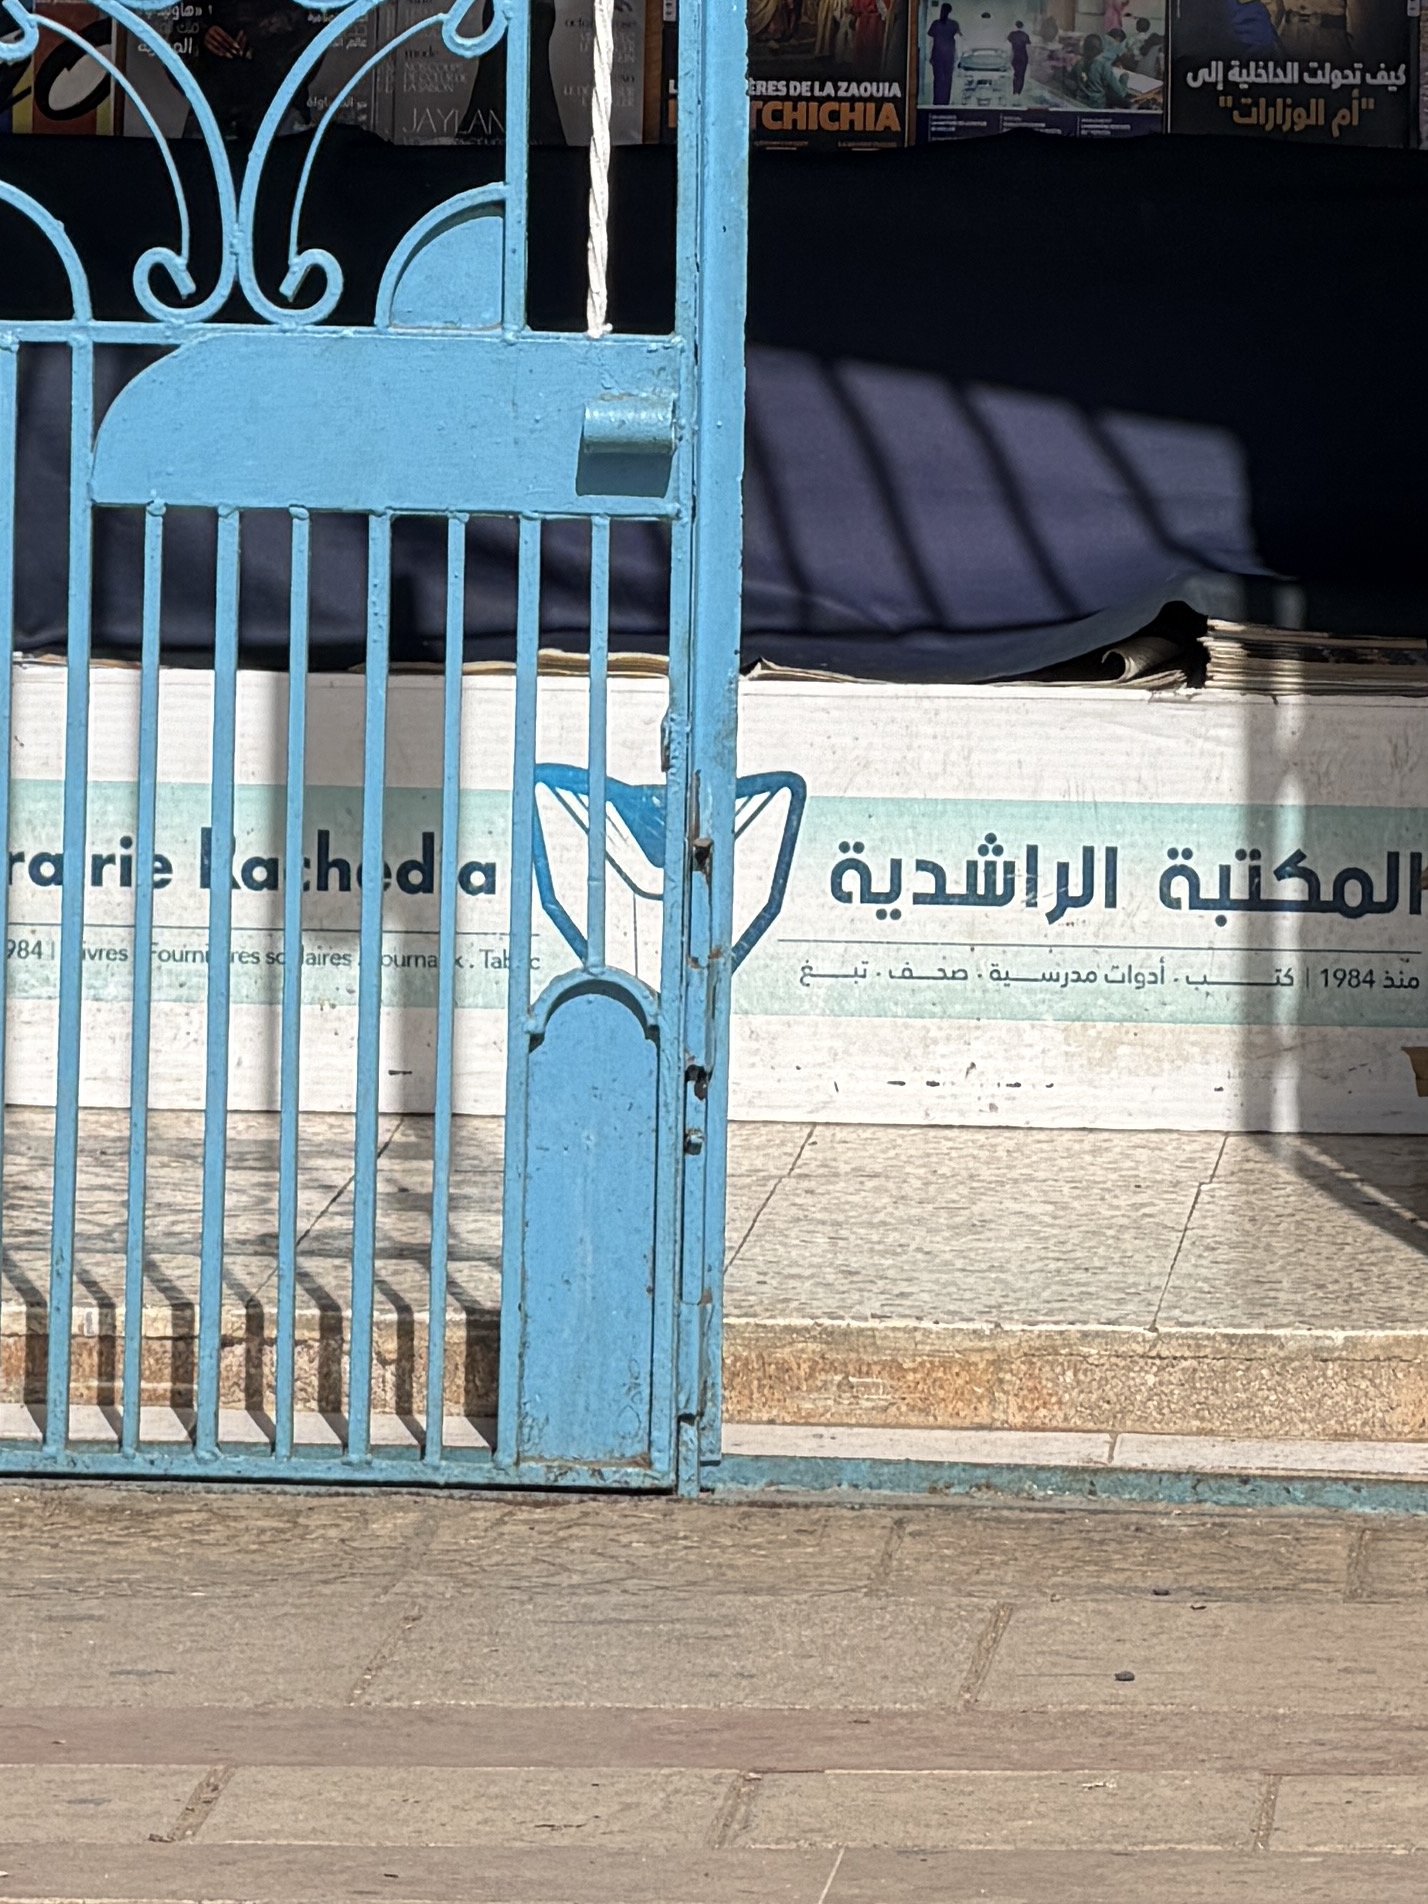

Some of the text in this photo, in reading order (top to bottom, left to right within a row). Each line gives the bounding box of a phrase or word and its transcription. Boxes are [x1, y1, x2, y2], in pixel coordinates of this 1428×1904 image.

[788, 80, 812, 97] DE
[813, 81, 836, 98] LA
[836, 81, 902, 99] ZAOUIA
[1186, 60, 1407, 92] كيف تحولت الداخلية إلى
[748, 100, 902, 132] TCHICHIA
[829, 832, 1424, 928] المكتبة الراشدية
[6, 938, 44, 960] 984
[81, 944, 129, 962] ivres
[474, 948, 540, 971] Tabc
[888, 961, 969, 988] صحف
[990, 963, 1099, 990] مدرسية
[1103, 957, 1165, 988] أدوات
[1320, 967, 1376, 989] 1984
[1383, 957, 1420, 990] منذ
